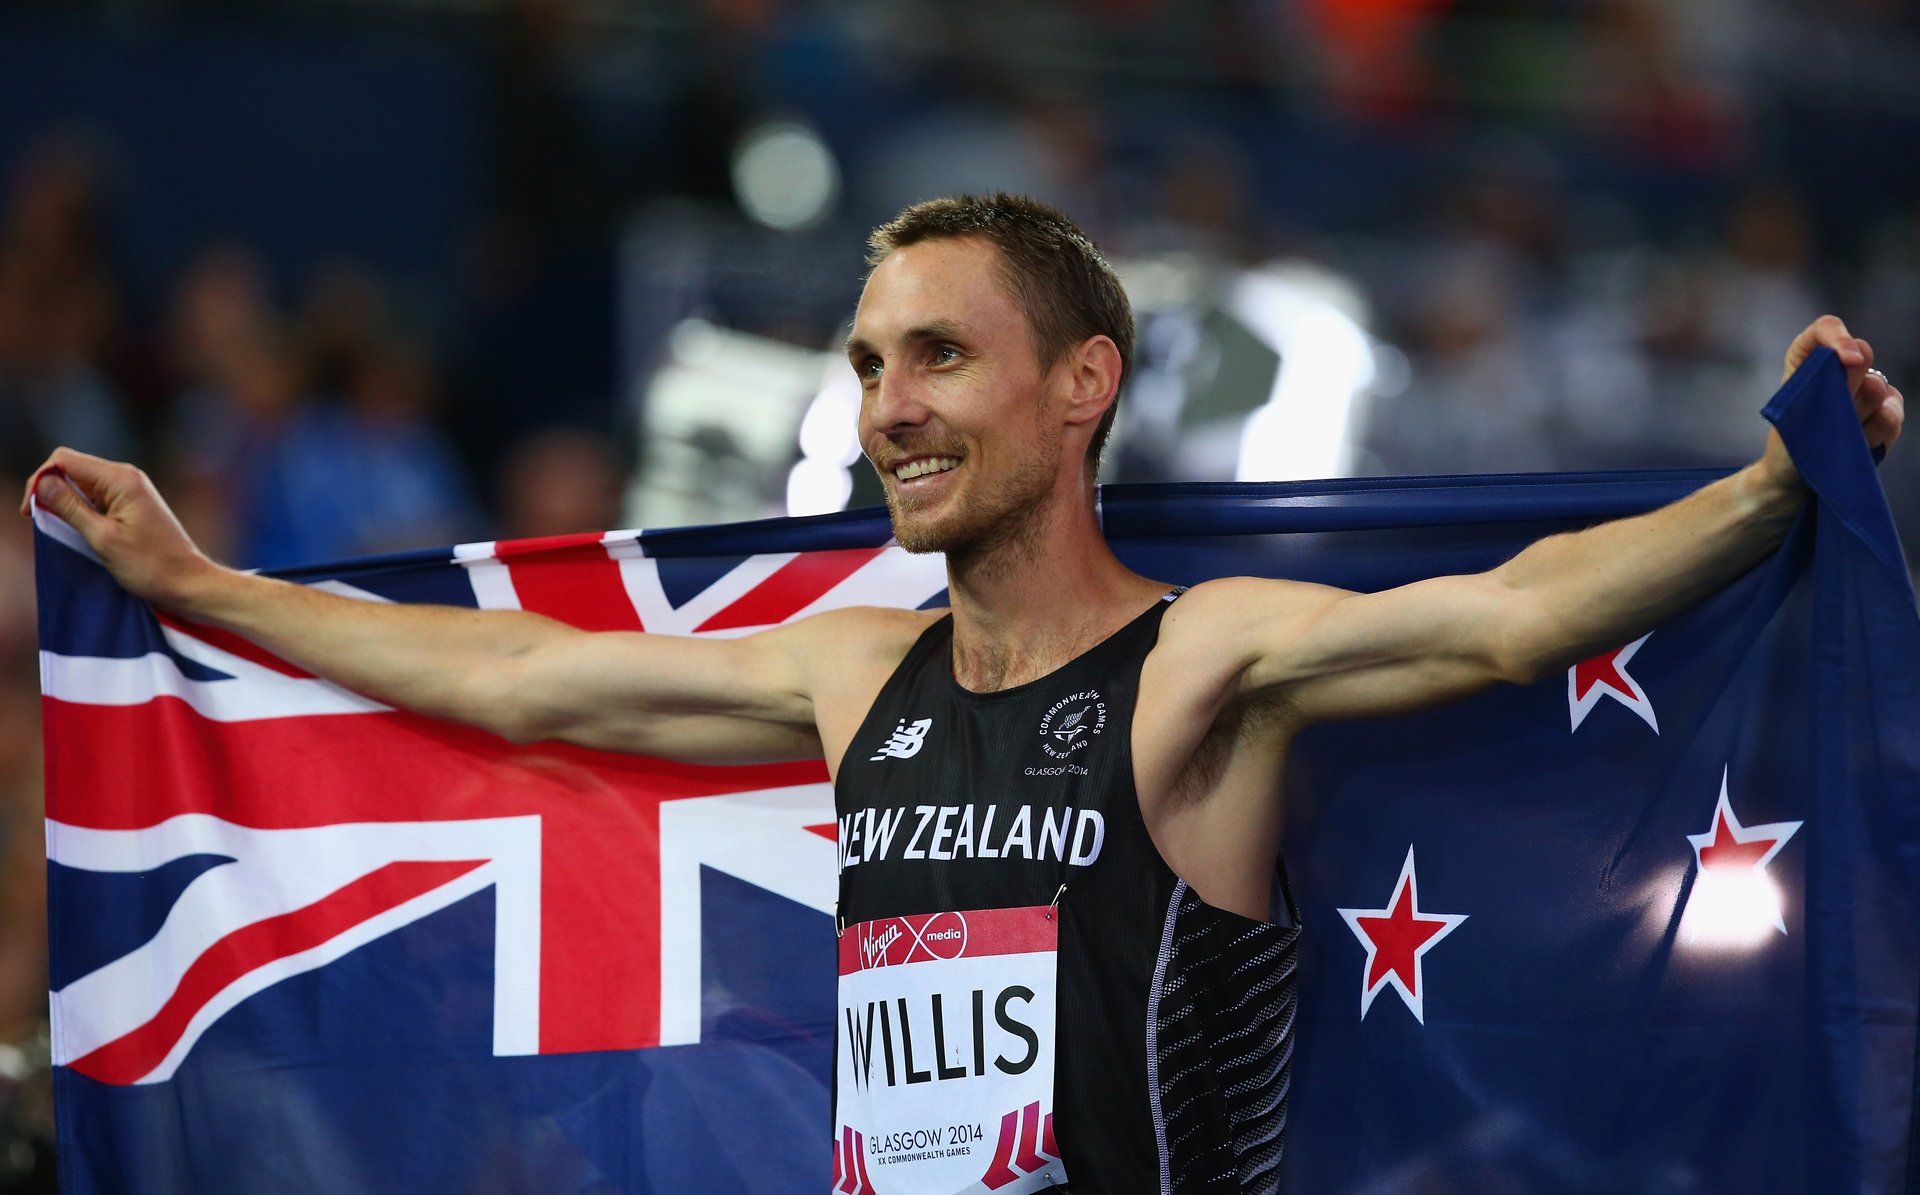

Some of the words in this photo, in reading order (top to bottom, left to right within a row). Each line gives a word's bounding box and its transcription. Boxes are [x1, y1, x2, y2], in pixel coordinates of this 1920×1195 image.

[1092, 702, 1107, 735] GAMES
[1042, 742, 1057, 757] NEW
[1068, 763, 1089, 776] 2014
[838, 806, 906, 875] NEW
[903, 803, 1106, 867] ZEALAND
[863, 922, 903, 967] Virgin
[926, 928, 962, 942] media
[846, 985, 1039, 1095] WILLIS
[869, 1128, 942, 1155] GLASGOW
[948, 1123, 983, 1145] 2014
[877, 1156, 887, 1165] XX
[888, 1149, 945, 1165] COMMONWEALTH
[946, 1146, 971, 1157] GAMES
